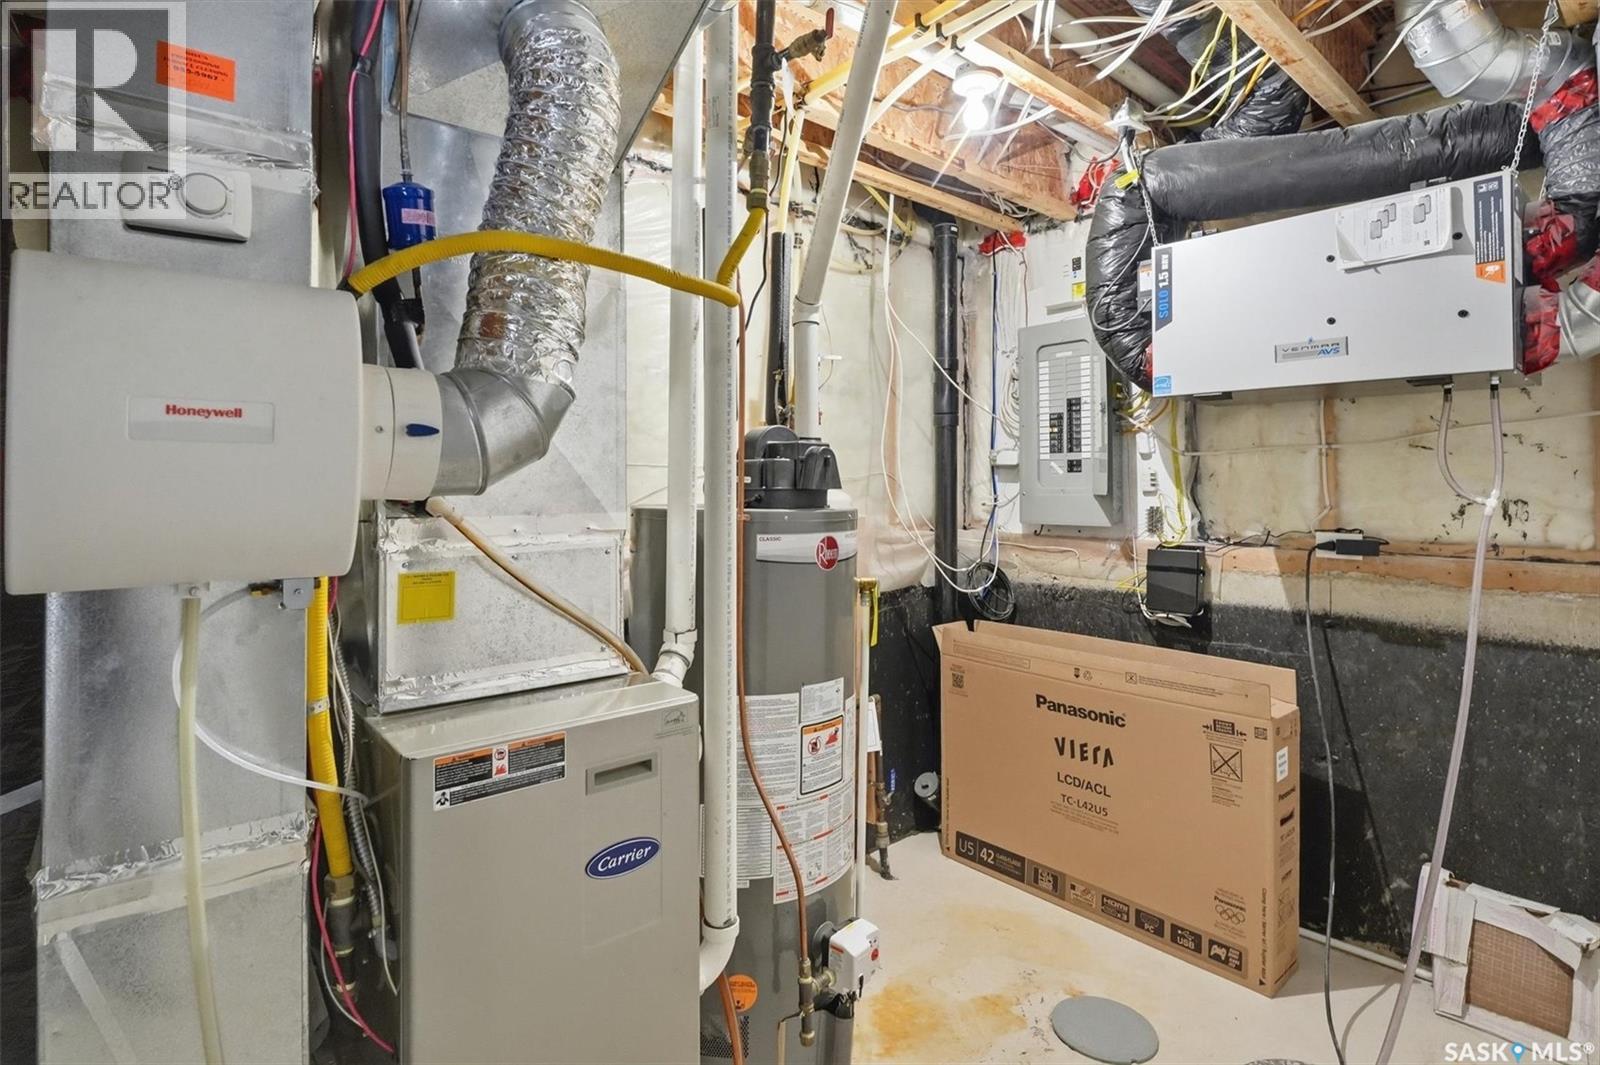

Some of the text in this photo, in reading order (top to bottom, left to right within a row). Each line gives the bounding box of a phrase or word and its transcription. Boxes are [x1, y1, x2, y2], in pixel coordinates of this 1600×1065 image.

[1158, 271, 1169, 288] 1.5
[1158, 289, 1169, 319] SOLO
[1317, 346, 1341, 356] AVS
[165, 404, 243, 419] Honeywell
[1035, 693, 1127, 728] Panasonic
[1054, 736, 1115, 769] VIERA
[1057, 771, 1112, 798] LCD/ACL
[1061, 793, 1109, 817] TC-L42U5
[597, 845, 652, 872] Carrier
[979, 847, 996, 865] 42
[1176, 936, 1196, 950] USB
